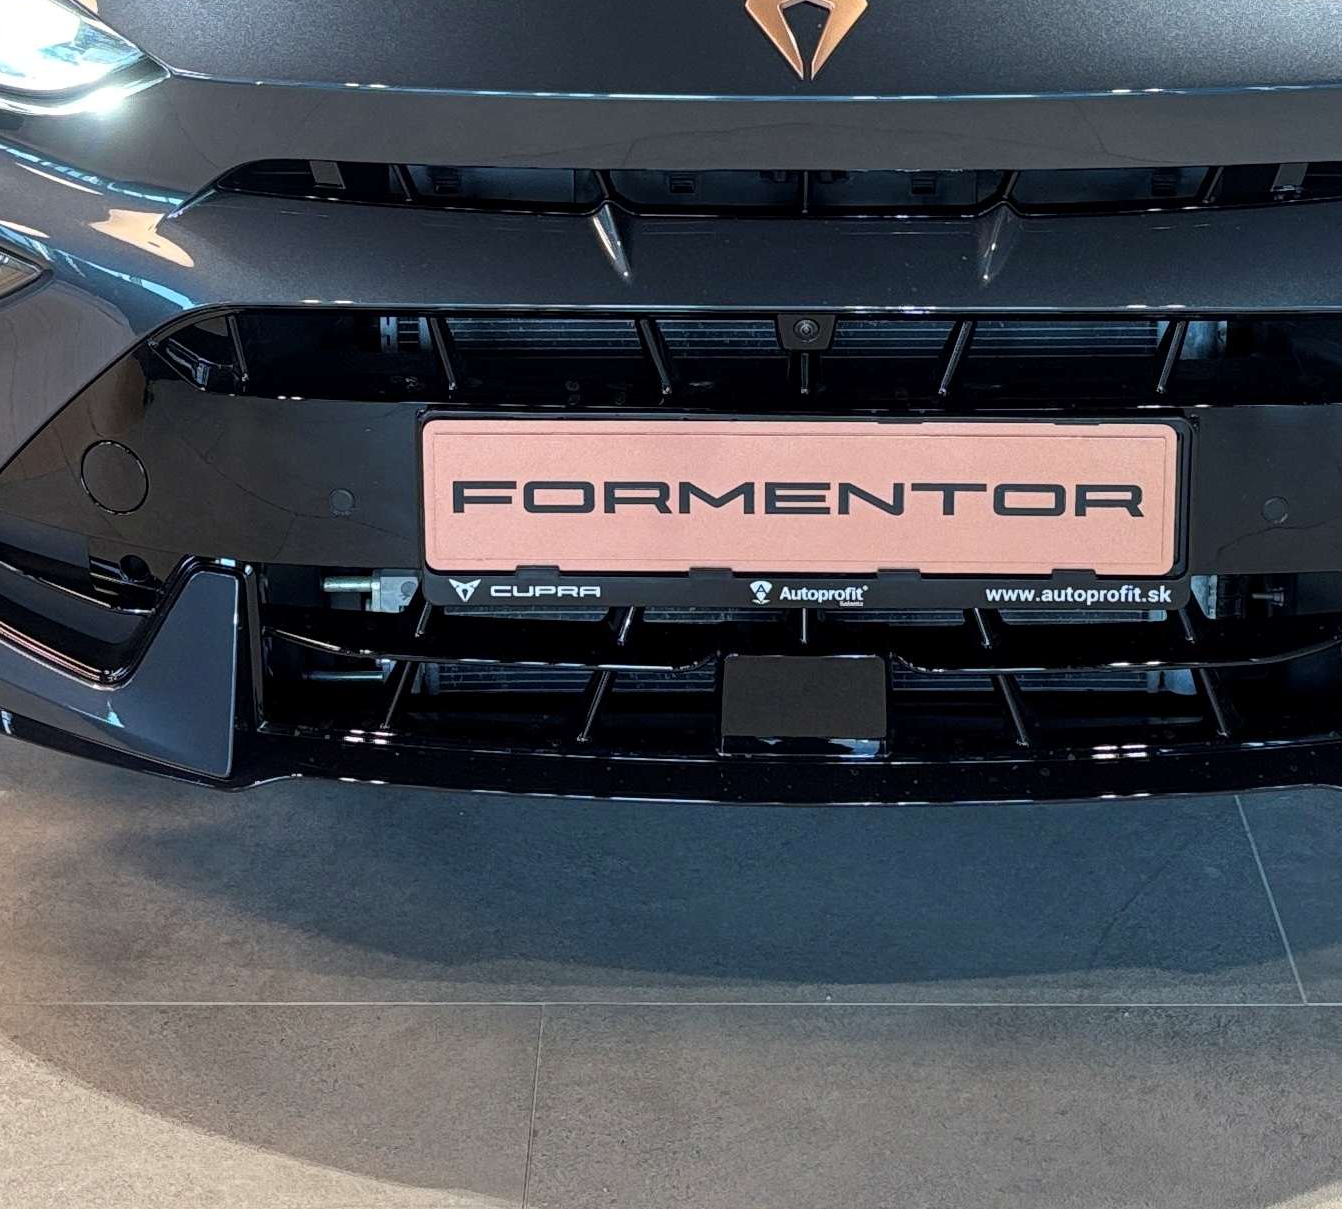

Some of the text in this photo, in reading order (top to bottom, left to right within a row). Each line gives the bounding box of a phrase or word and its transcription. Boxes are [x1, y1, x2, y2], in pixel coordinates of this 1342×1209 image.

[452, 480, 1145, 518] FORMENTOR
[490, 585, 601, 598] CUPRA
[985, 584, 1171, 606] www.autoprofit.sk
